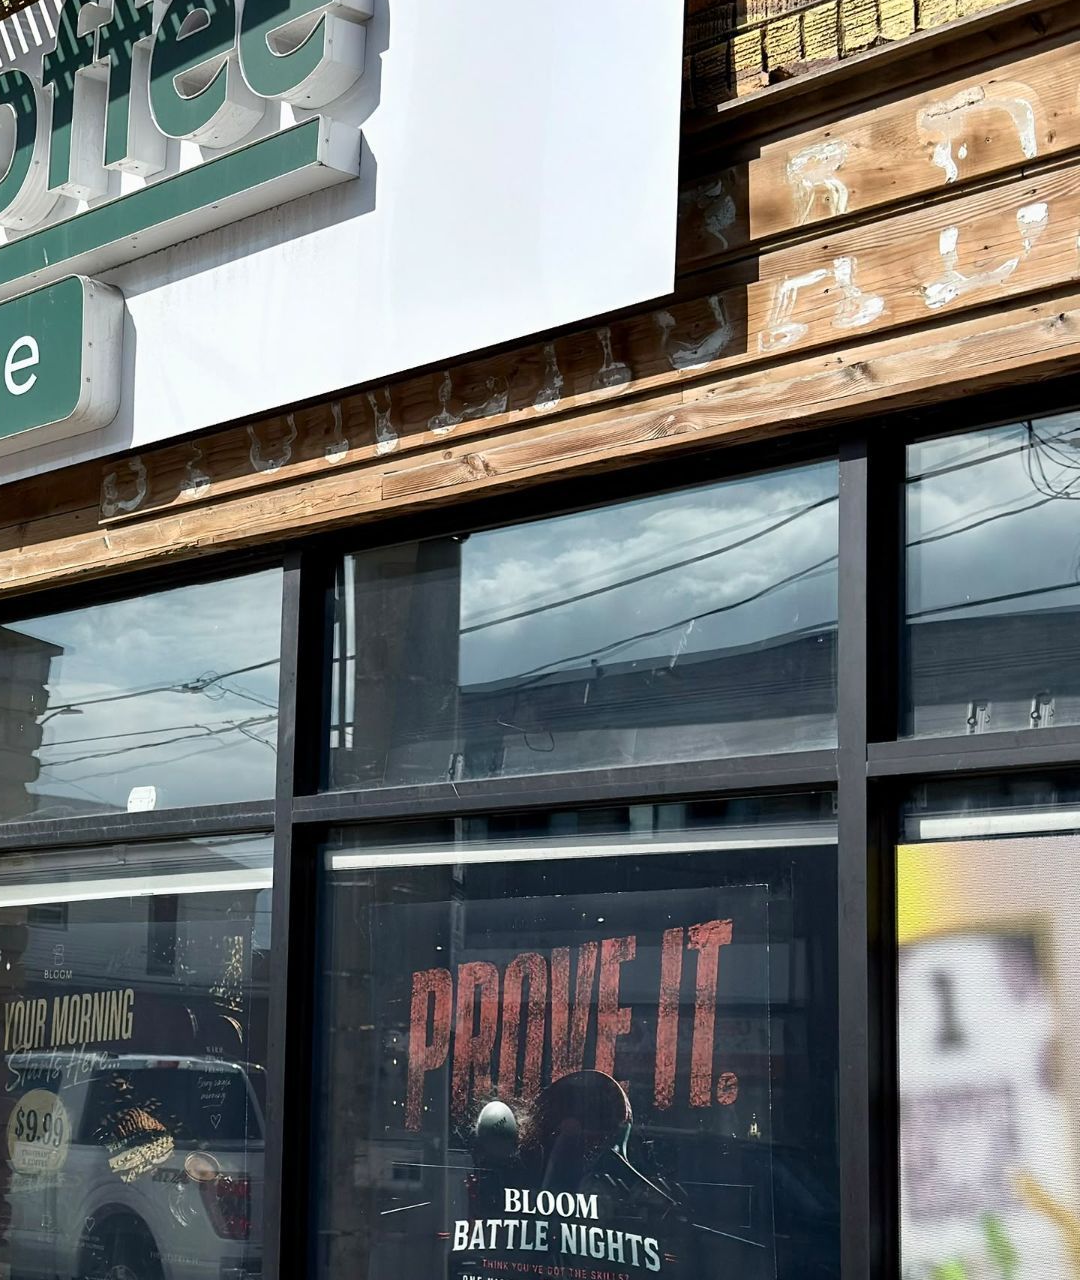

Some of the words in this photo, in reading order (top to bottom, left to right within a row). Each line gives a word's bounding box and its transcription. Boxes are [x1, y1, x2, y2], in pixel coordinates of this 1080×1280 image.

[44, 969, 73, 980] BLOOM
[4, 998, 48, 1052] YOUR
[50, 987, 135, 1047] MORNING
[406, 934, 637, 1131] PROVE
[652, 918, 739, 1111] IT.
[5, 1045, 62, 1093] Starts
[14, 1106, 64, 1148] $9.99
[503, 1188, 599, 1220] BLOOM
[452, 1219, 549, 1252] BATTLE
[560, 1222, 661, 1272] NIGHTS
[482, 1259, 508, 1270] THINK
[570, 1269, 587, 1280] THE
